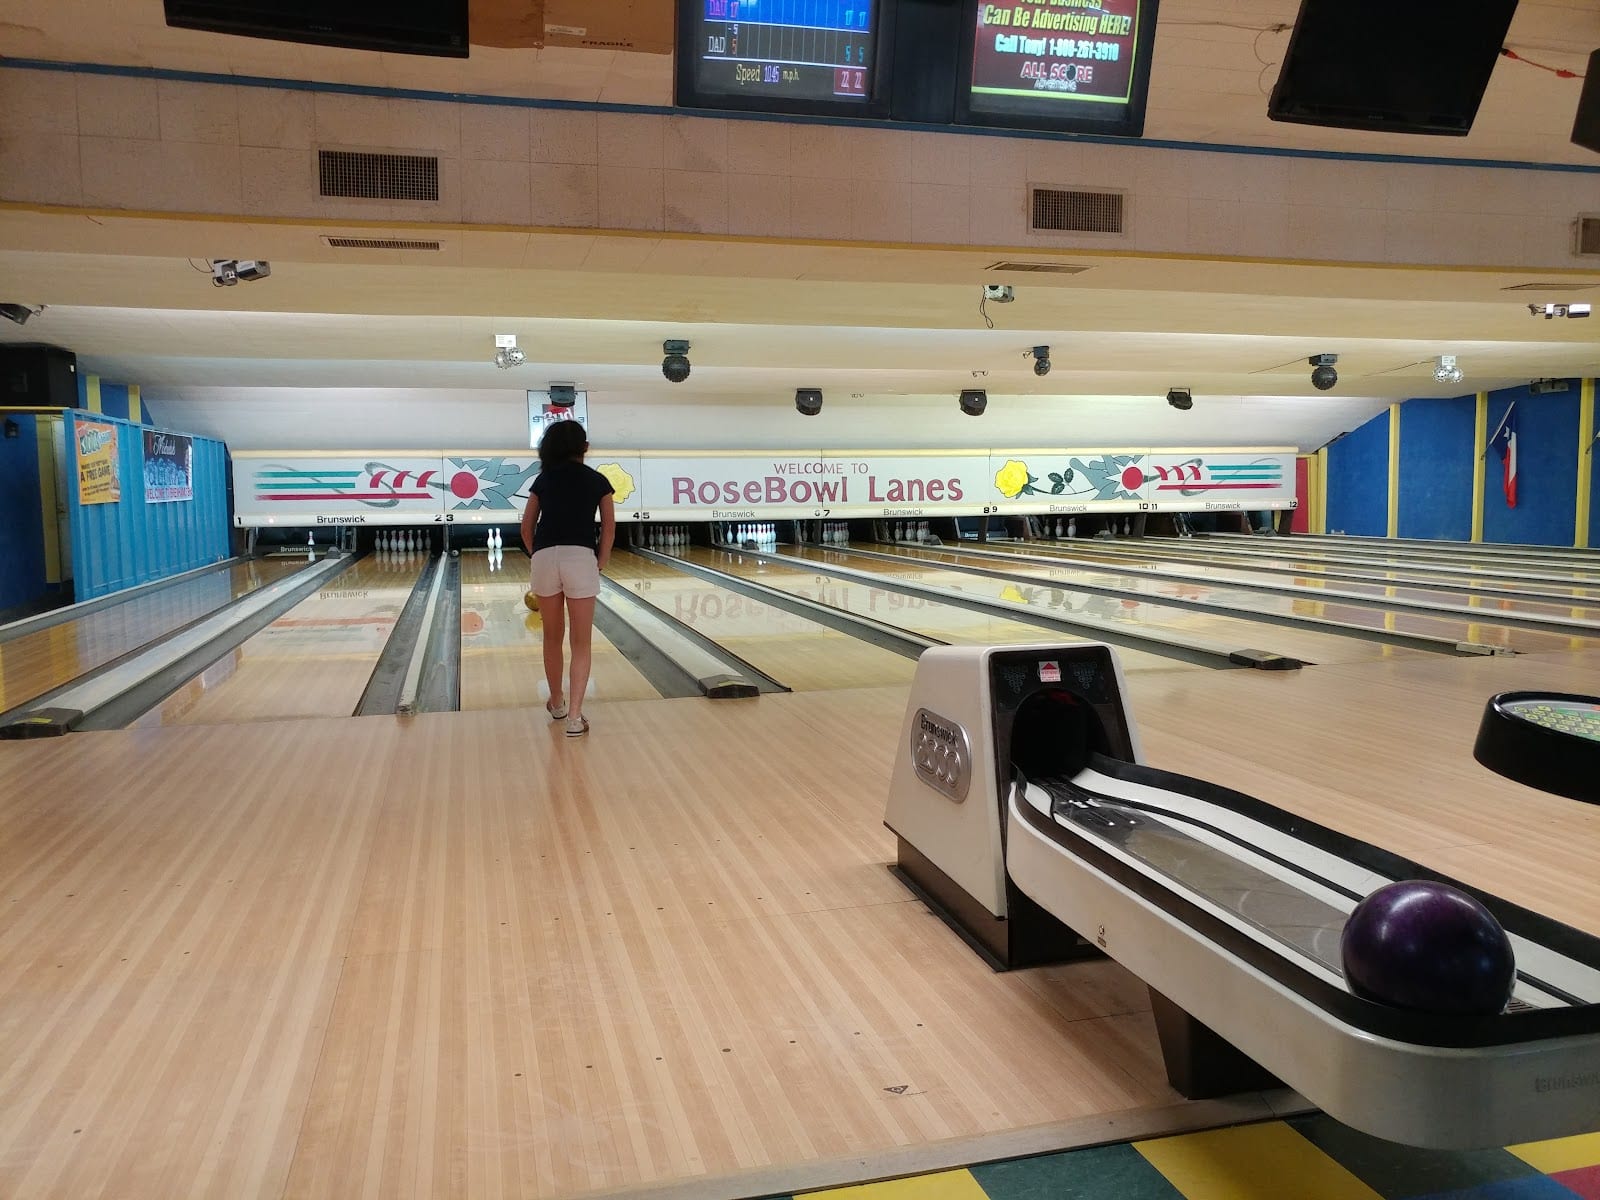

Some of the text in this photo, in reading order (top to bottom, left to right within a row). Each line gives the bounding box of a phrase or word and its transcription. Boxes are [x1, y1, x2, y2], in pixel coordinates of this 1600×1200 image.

[983, 4, 1132, 36] Can Be Advertising HERE!
[708, 36, 725, 53] DAD
[995, 33, 1018, 53] Call
[736, 64, 761, 85] Speed
[1020, 61, 1047, 80] ALL
[773, 463, 869, 475] WELCOME TO
[672, 475, 964, 505] RoseBowl Lanes
[1049, 504, 1087, 512] Brunswick
[1205, 502, 1241, 510] Brunswick
[632, 512, 640, 520] 4
[642, 512, 650, 520] 5
[712, 510, 756, 518] Brunswick
[883, 508, 923, 516] Brunswick
[316, 515, 366, 524] Brunswick
[434, 514, 443, 522] 2
[445, 514, 454, 522] 3
[920, 713, 958, 745] Brunswick
